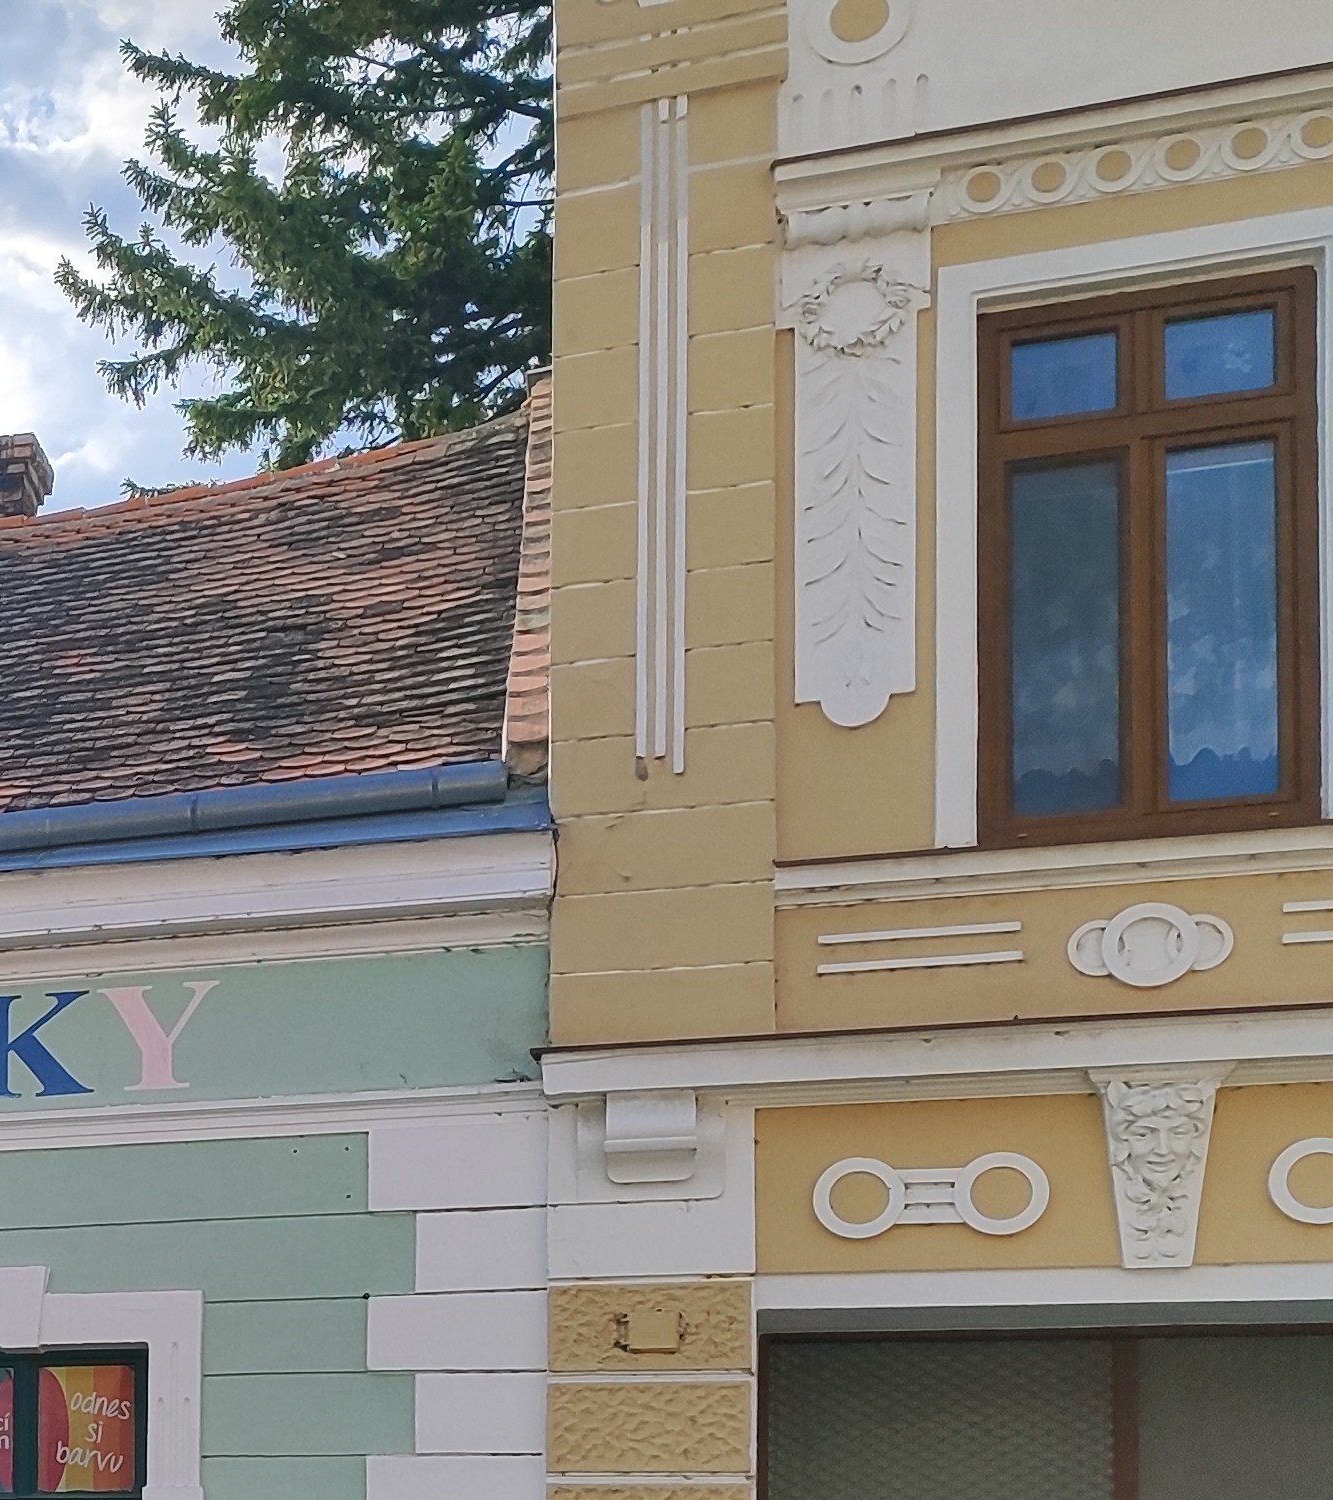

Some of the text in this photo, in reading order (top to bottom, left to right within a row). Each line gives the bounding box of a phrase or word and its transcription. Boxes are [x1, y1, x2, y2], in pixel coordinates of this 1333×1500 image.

[70, 1391, 131, 1420] odnes
[84, 1420, 104, 1444] si
[56, 1440, 124, 1473] barvu
